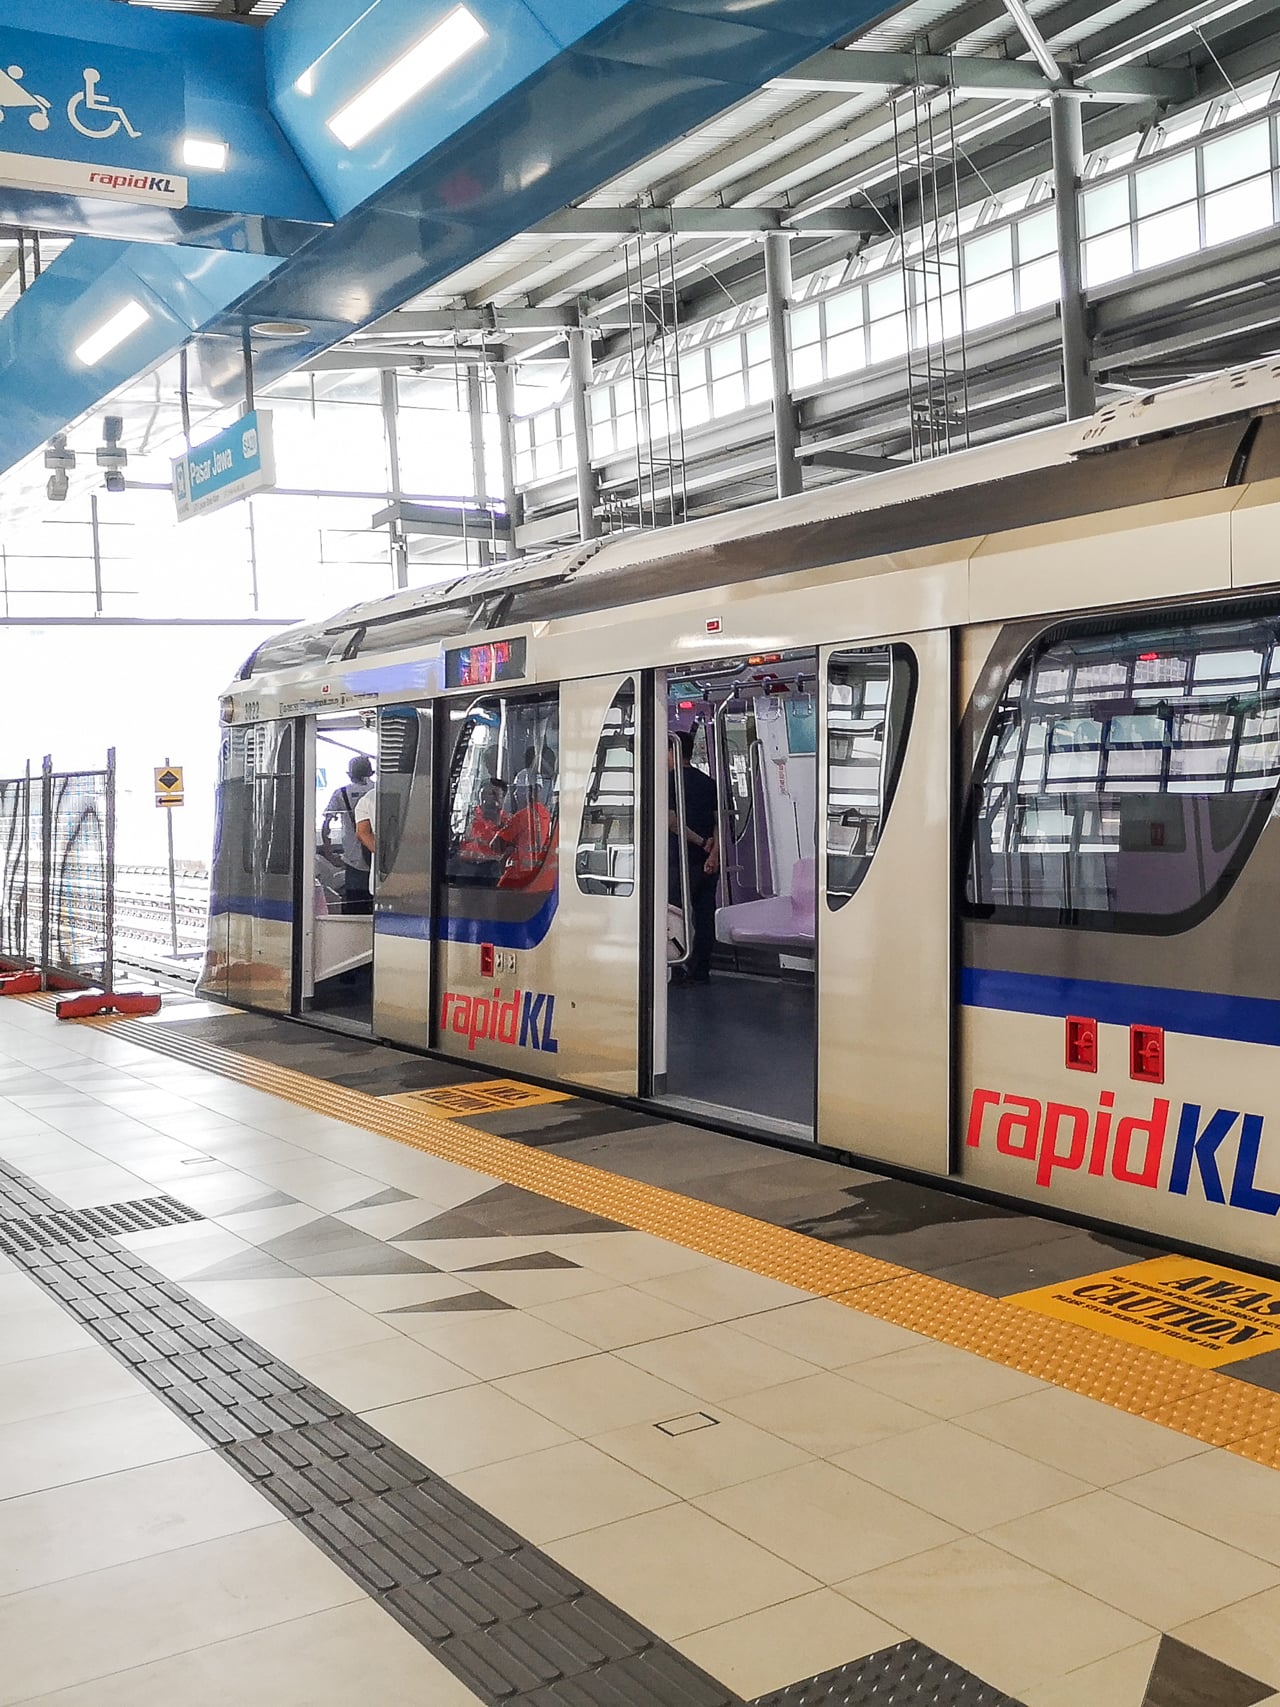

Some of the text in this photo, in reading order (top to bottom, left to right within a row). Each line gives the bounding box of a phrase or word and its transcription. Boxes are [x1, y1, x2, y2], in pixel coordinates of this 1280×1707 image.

[89, 172, 175, 193] rapidKL
[190, 459, 211, 486] Pasar
[212, 448, 233, 476] Jawa
[440, 987, 558, 1053] rapidKL
[1072, 1283, 1274, 1345] CAUTION
